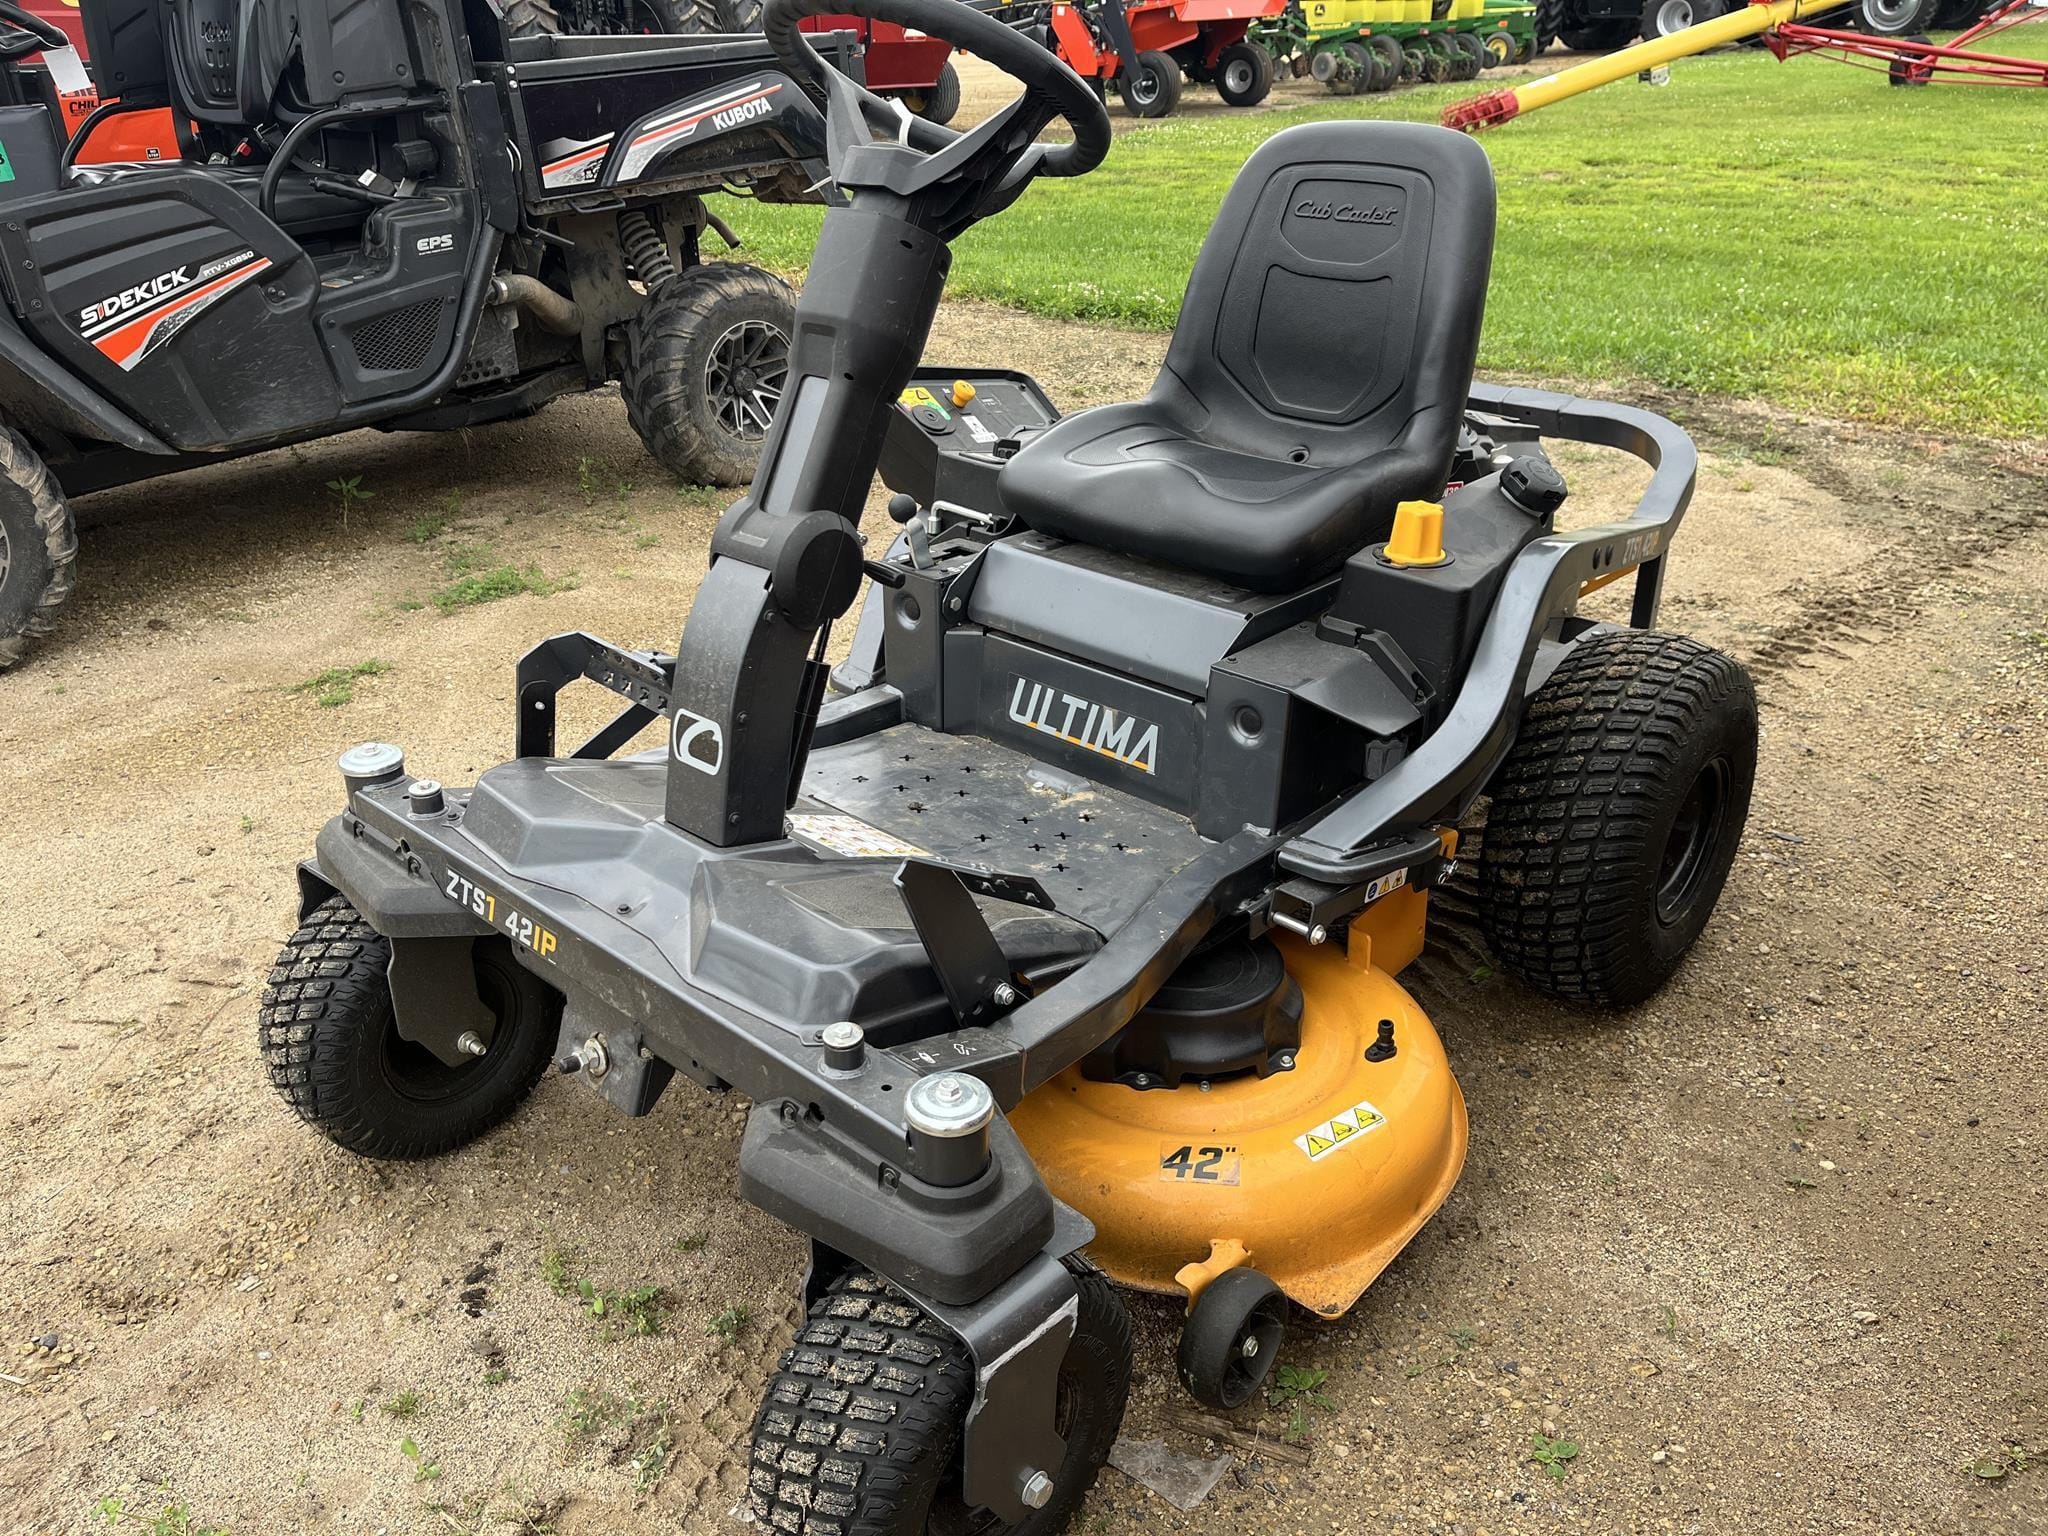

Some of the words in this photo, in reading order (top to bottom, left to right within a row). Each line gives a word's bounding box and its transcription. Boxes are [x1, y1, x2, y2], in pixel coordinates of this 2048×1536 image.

[711, 97, 772, 131] KUBOTA
[1295, 200, 1332, 220] Cub
[1334, 204, 1398, 226] Cadet
[417, 233, 453, 251] EPS
[79, 265, 191, 328] SIDEKICK
[1009, 677, 1159, 776] ULTIMA
[446, 869, 496, 922] ZTS1
[505, 911, 557, 957] 42IP
[1162, 1145, 1237, 1180] 42"
